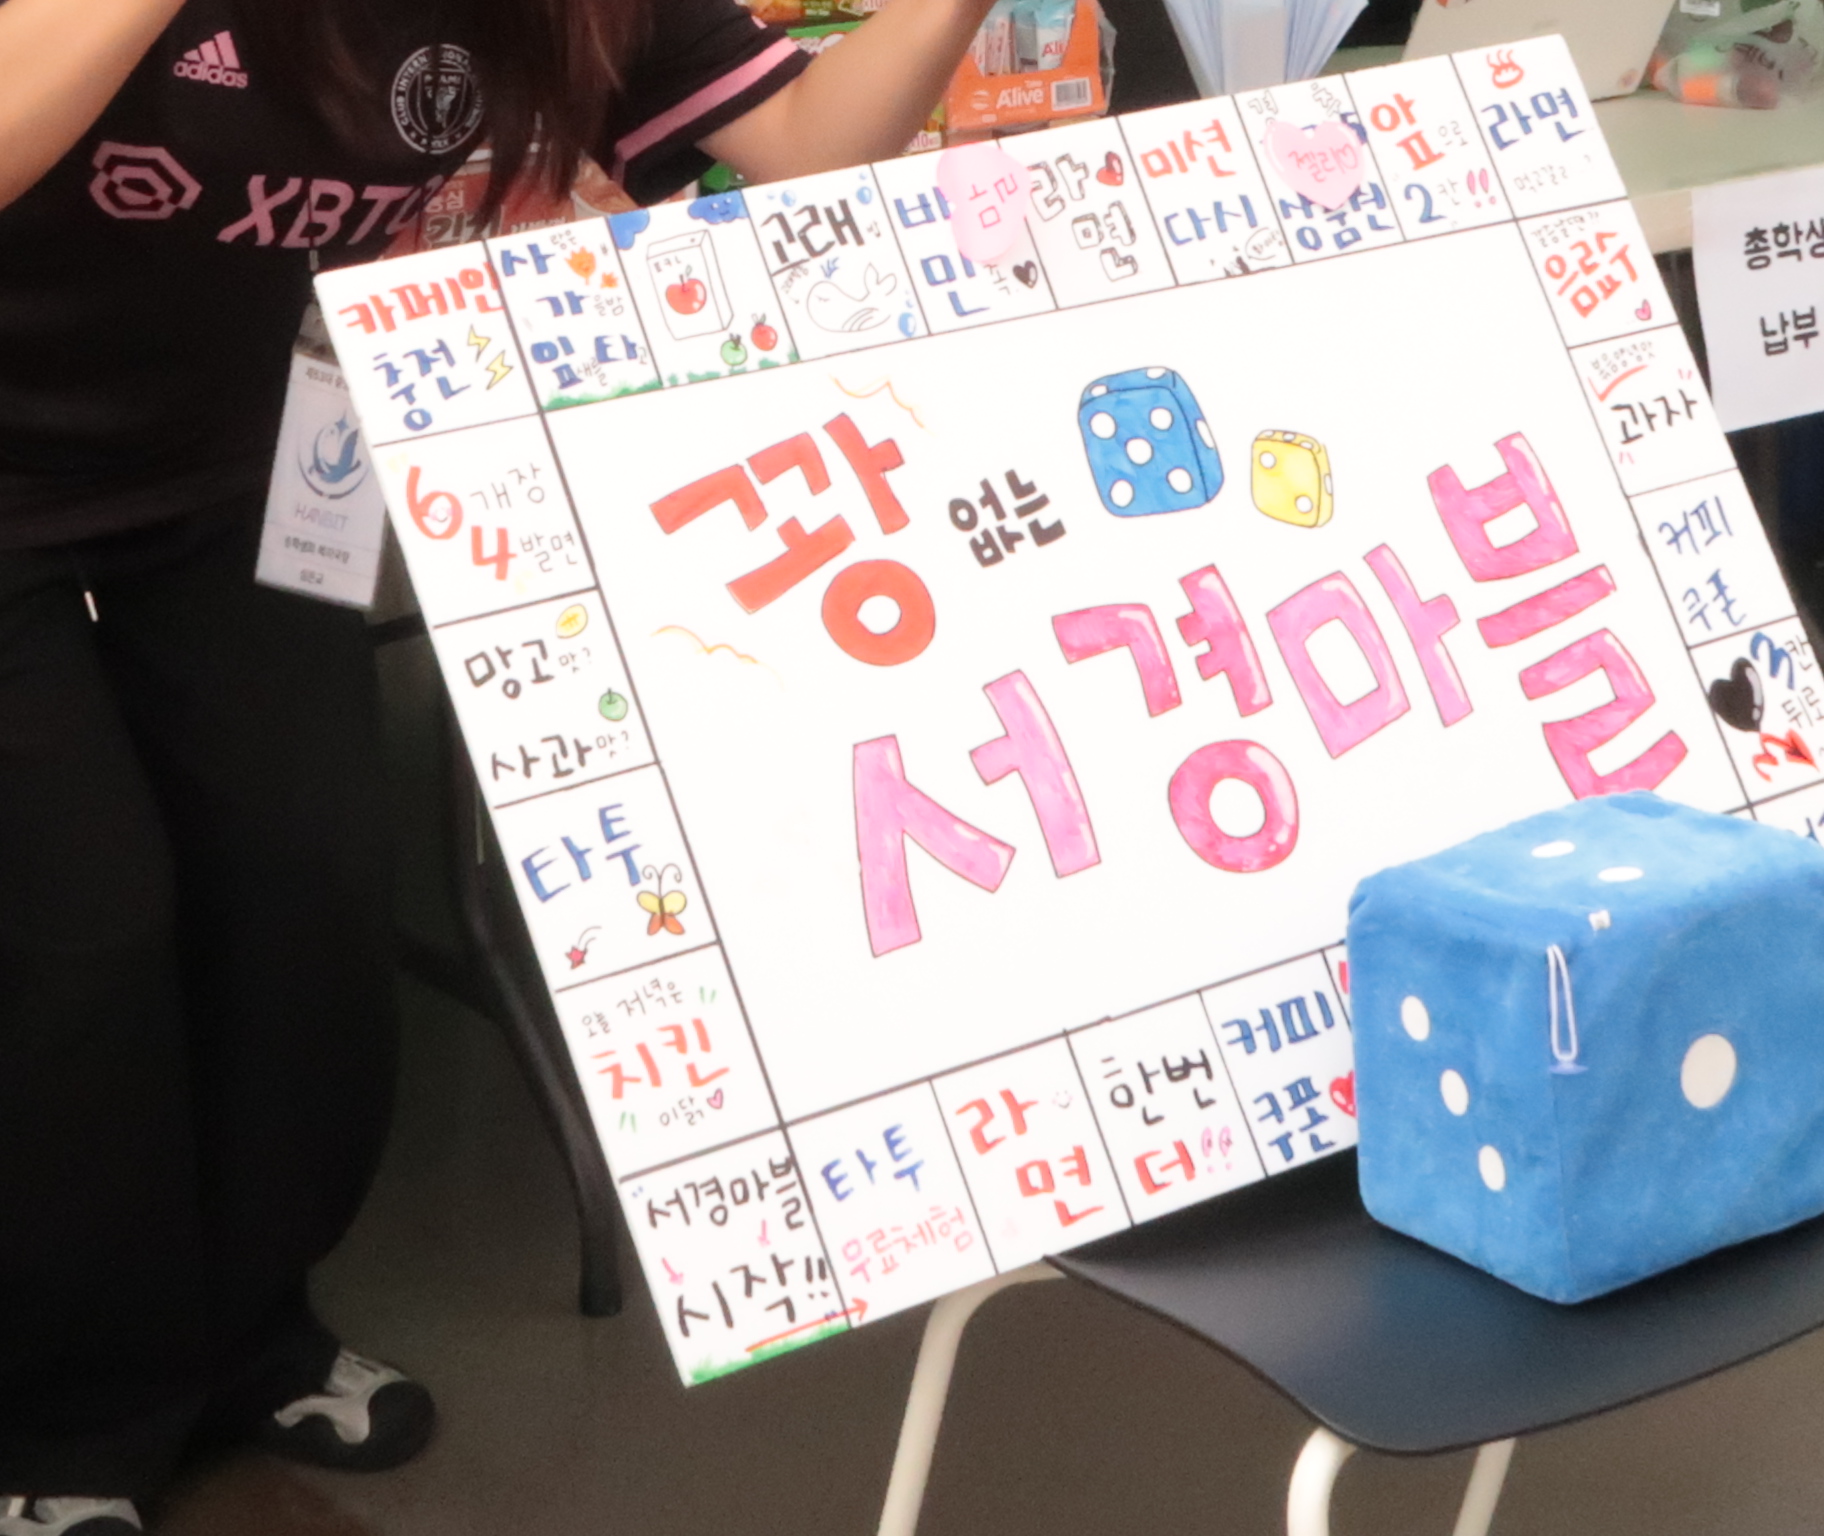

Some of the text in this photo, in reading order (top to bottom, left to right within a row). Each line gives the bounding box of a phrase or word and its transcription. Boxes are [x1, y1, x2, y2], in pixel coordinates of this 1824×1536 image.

[173, 61, 249, 89] adidas
[996, 85, 1044, 109] Alive
[1139, 118, 1237, 178] 미션
[1369, 92, 1468, 171] 앞으로
[1480, 86, 1587, 151] 라면
[1027, 153, 1139, 282] 라면
[1163, 194, 1259, 246] 다시
[338, 261, 505, 334] 카페인
[1760, 306, 1819, 356] 납부
[373, 338, 472, 431] 충전
[1610, 388, 1698, 445] 과자
[647, 411, 1068, 667] 꽝 없는
[1657, 495, 1735, 556] 커피
[1682, 568, 1747, 632] 쿠폰
[850, 430, 1691, 959] 서경마블
[520, 802, 643, 904] 타투
[590, 1017, 731, 1100] 치킨
[1221, 989, 1336, 1056] 커피
[1100, 1048, 1217, 1127] 한번
[1252, 1075, 1338, 1164] 쿠폰
[646, 1156, 806, 1231] 서경마블
[820, 1122, 926, 1203] 타투
[955, 1087, 1106, 1229] 라면
[675, 1252, 831, 1339] 시작!!
